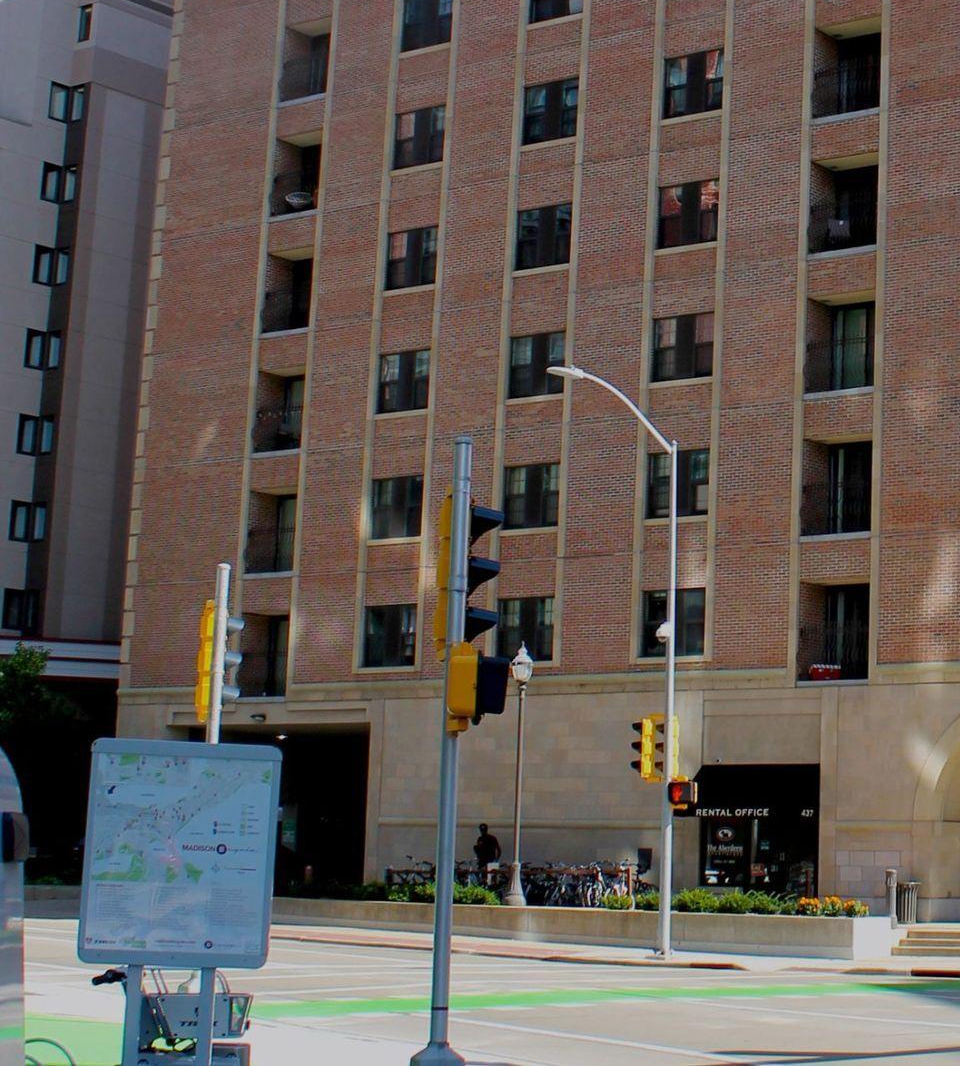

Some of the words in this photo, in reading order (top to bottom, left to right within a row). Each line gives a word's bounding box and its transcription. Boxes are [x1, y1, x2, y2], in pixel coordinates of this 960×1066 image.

[695, 808, 733, 817] RENTAL
[735, 808, 770, 817] OFFICE
[182, 844, 215, 852] MADISON
